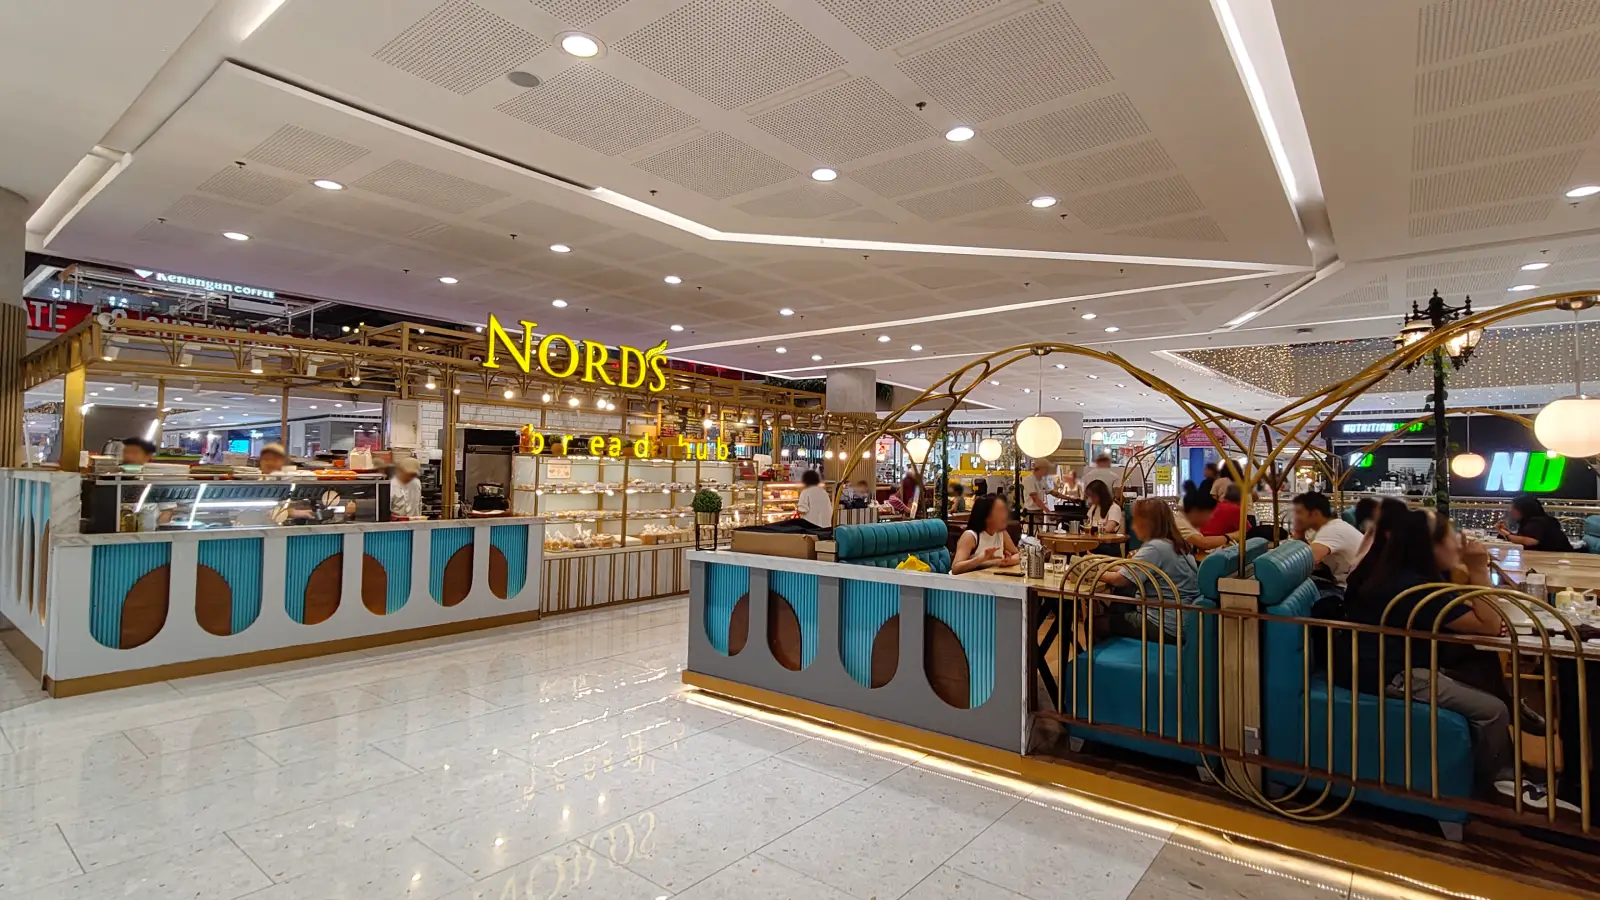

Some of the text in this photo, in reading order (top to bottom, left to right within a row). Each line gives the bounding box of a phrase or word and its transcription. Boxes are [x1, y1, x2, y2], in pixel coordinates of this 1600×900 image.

[156, 272, 275, 299] Kenangan COFFEE
[529, 423, 649, 459] bread
[679, 434, 729, 461] hub
[1486, 452, 1566, 492] ND
